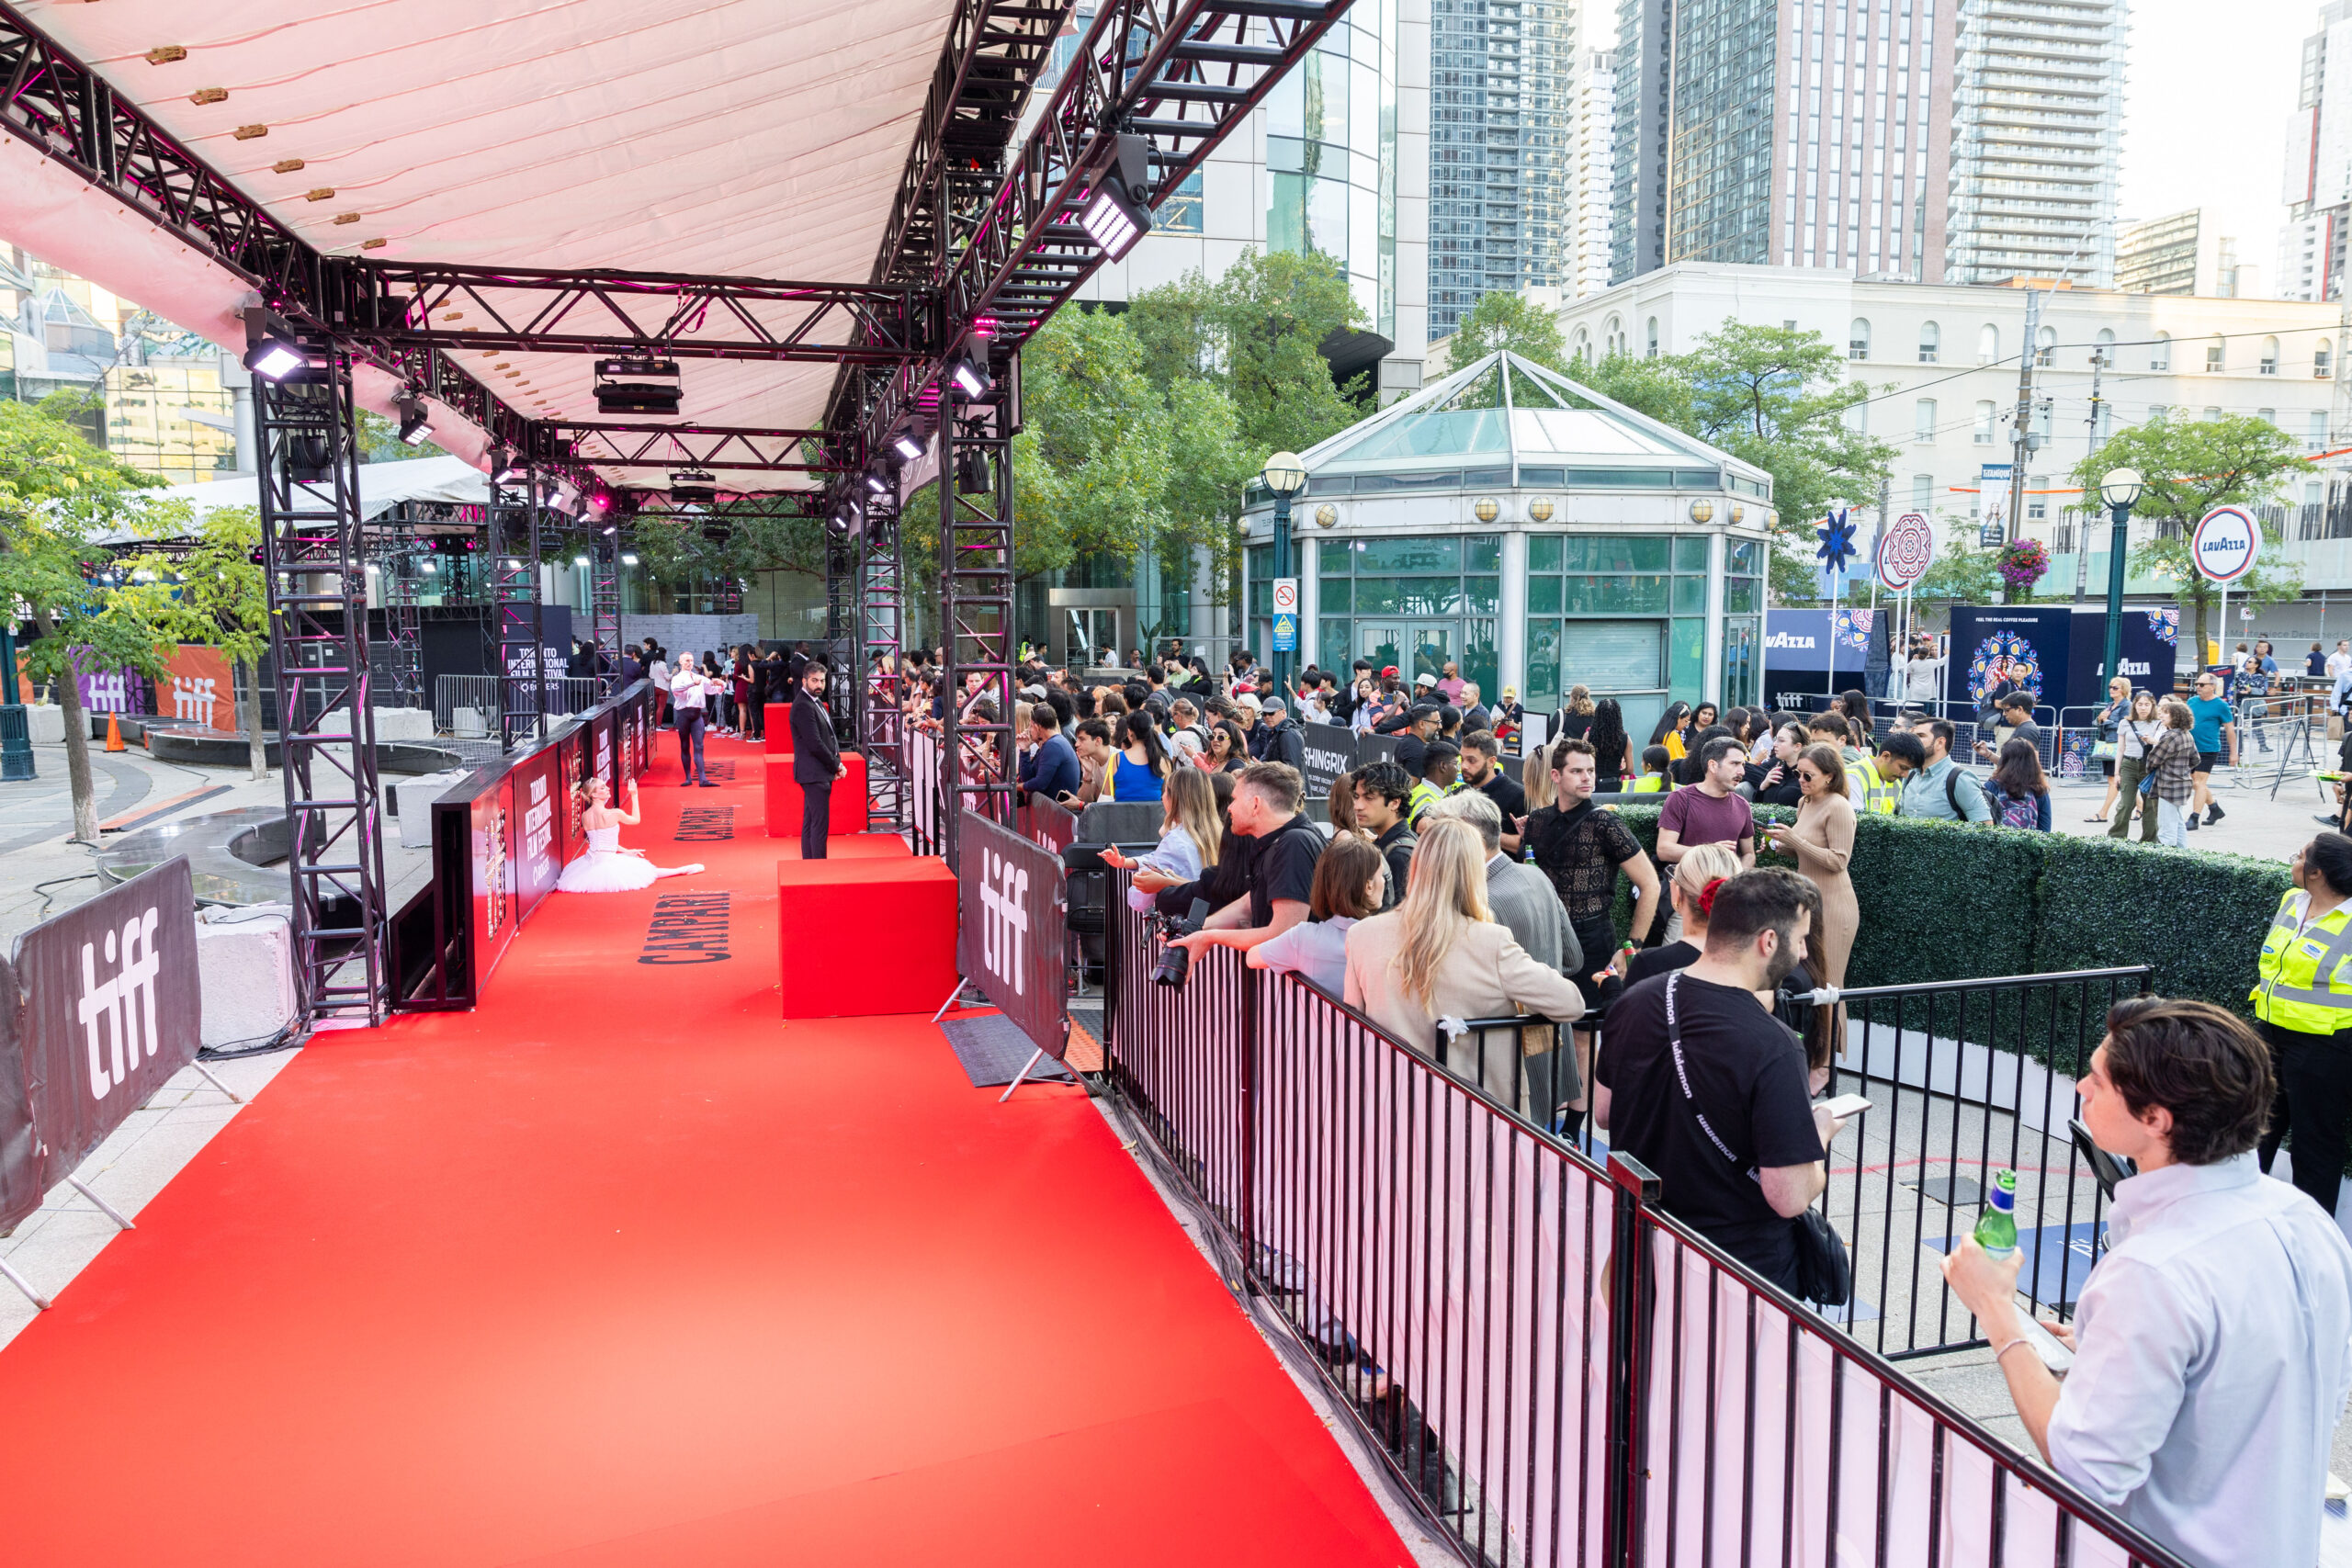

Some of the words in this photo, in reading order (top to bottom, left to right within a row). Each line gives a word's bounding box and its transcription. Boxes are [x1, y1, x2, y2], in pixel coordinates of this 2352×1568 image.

[2203, 537, 2245, 551] LAVAZZA
[519, 648, 557, 658] TORNTO
[1766, 632, 1815, 649] VAZZA
[507, 659, 569, 670] INTERNIONAL
[532, 669, 568, 679] FSTIVAL
[2097, 658, 2151, 675] LAZZA
[173, 677, 217, 728] tiff
[1305, 747, 1348, 774] SHINGRIX
[673, 807, 735, 841] CAMPARI
[638, 893, 732, 964] CAMPARI
[979, 847, 1029, 996] tiff
[79, 907, 160, 1100] tiff
[1666, 973, 1681, 1025] lululemon
[1671, 1040, 1693, 1100] lululemon
[1696, 1113, 1738, 1163] lululemon
